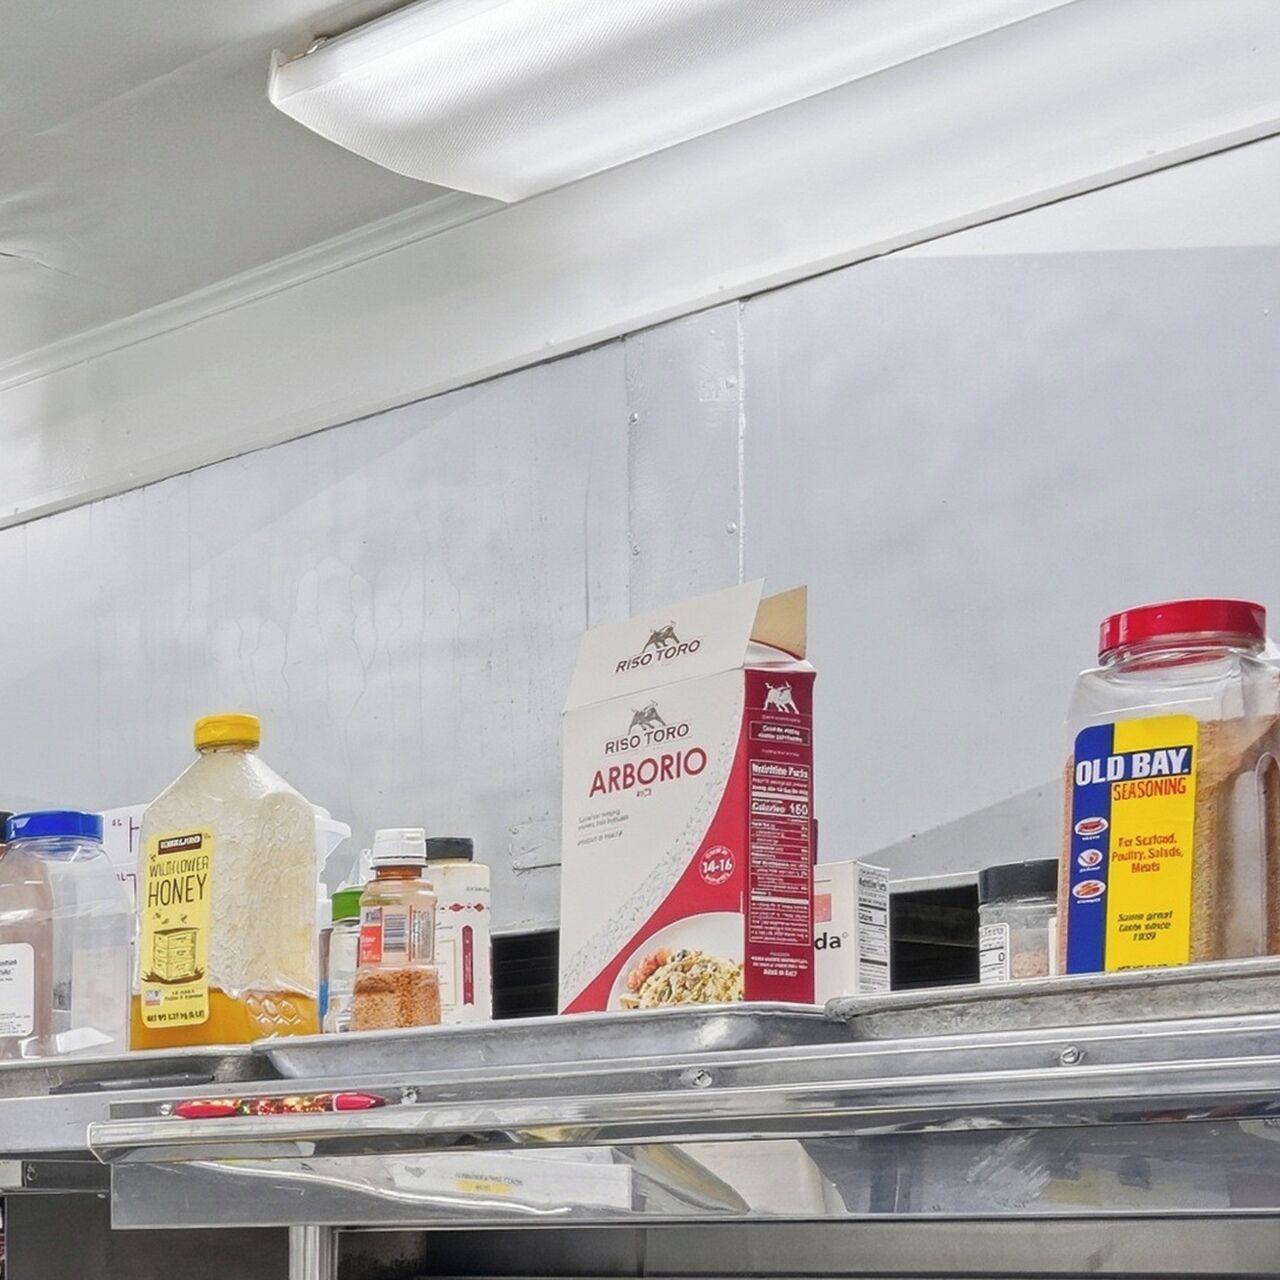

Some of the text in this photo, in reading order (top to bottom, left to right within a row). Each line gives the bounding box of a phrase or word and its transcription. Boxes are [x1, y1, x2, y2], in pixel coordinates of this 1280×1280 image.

[616, 640, 702, 673] RISO TORO
[605, 723, 690, 754] RISO TORO
[589, 747, 708, 798] ARBORIO
[1075, 755, 1125, 787] OLD
[1113, 777, 1187, 801] SEASONING
[1118, 837, 1133, 848] For
[149, 855, 210, 878] WILDFLOWER
[703, 858, 733, 873] 14-16
[148, 872, 208, 908] HONEY
[814, 931, 842, 951] da
